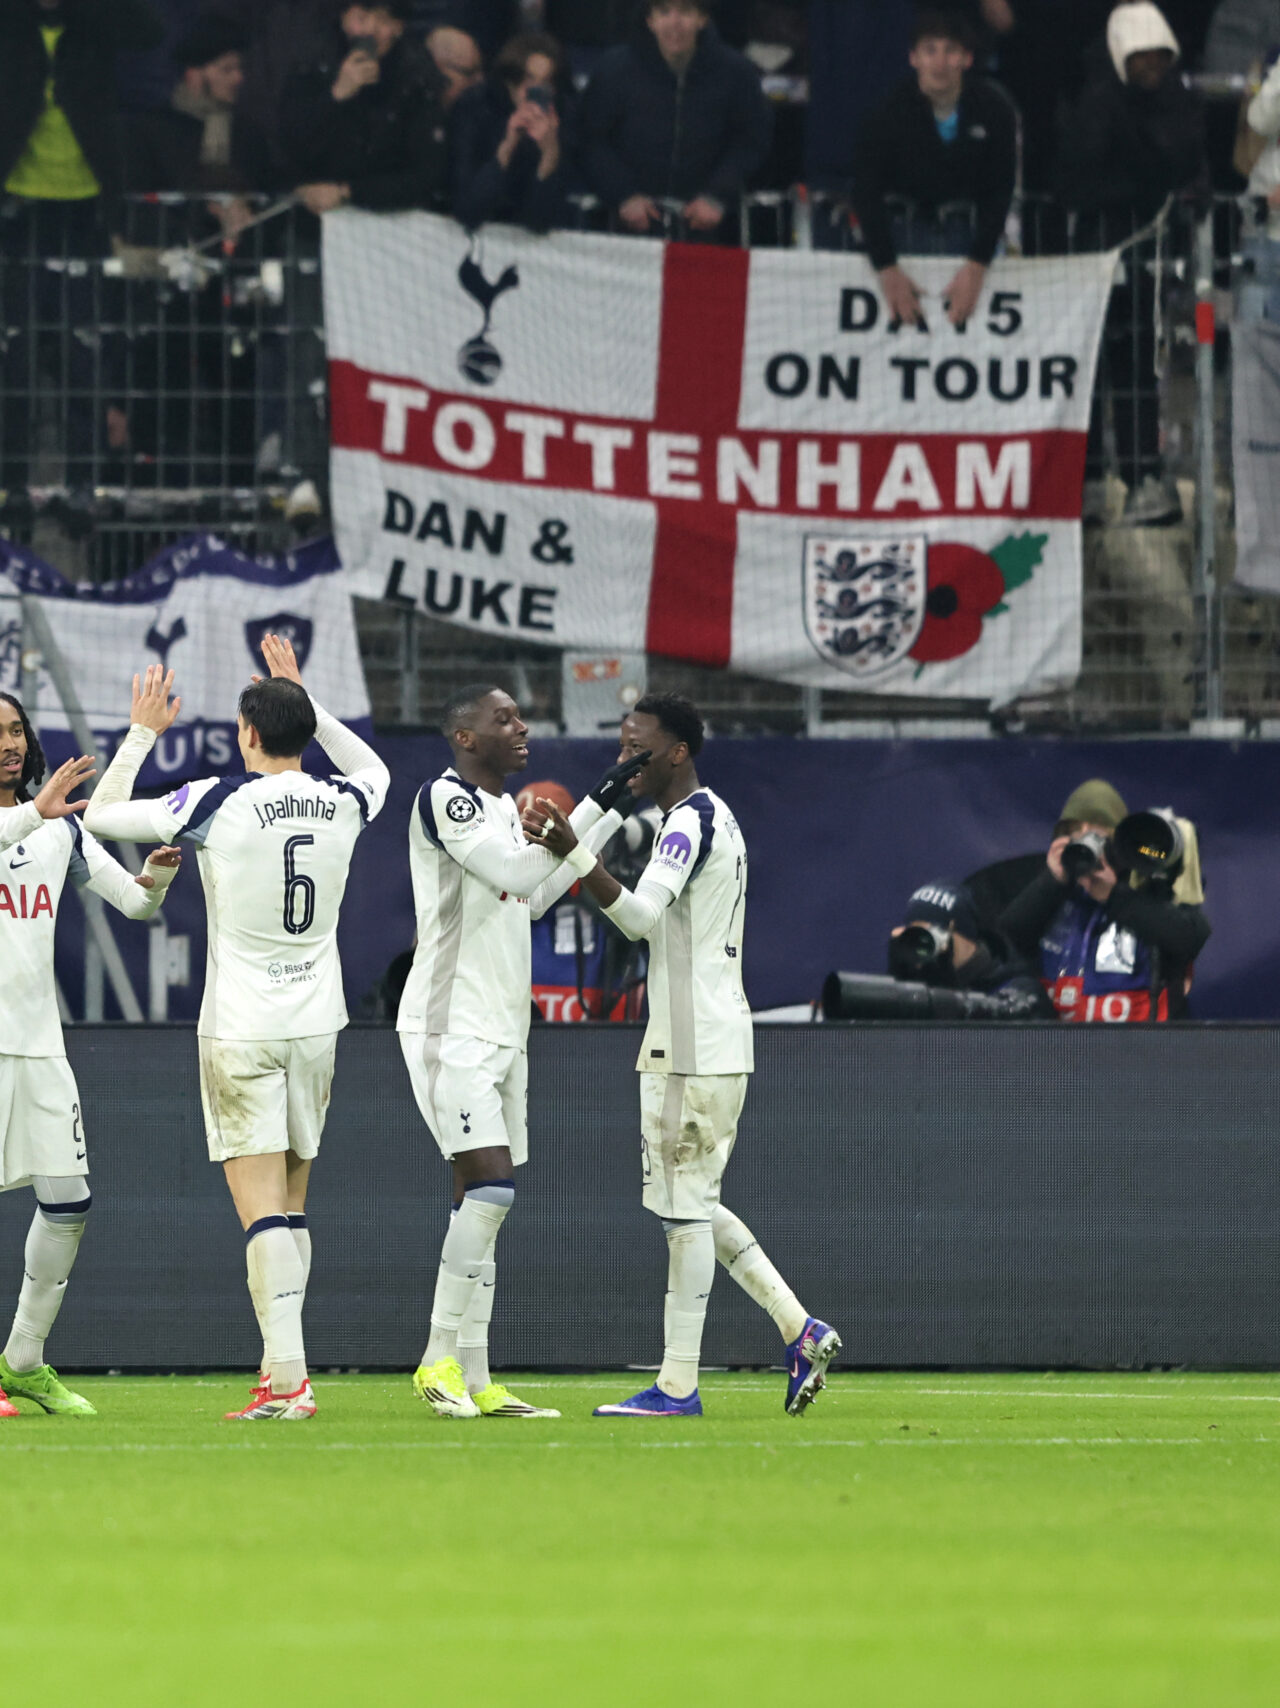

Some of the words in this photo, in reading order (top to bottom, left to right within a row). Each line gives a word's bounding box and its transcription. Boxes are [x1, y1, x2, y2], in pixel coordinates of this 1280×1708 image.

[765, 353, 860, 401] ON
[890, 355, 1078, 402] TOUR
[368, 382, 1031, 511] TOTTENHAM
[382, 490, 504, 557] DAN
[532, 518, 575, 565] &
[385, 559, 557, 633] LUKE
[253, 795, 336, 829] j.palhinha
[283, 834, 316, 935] 6
